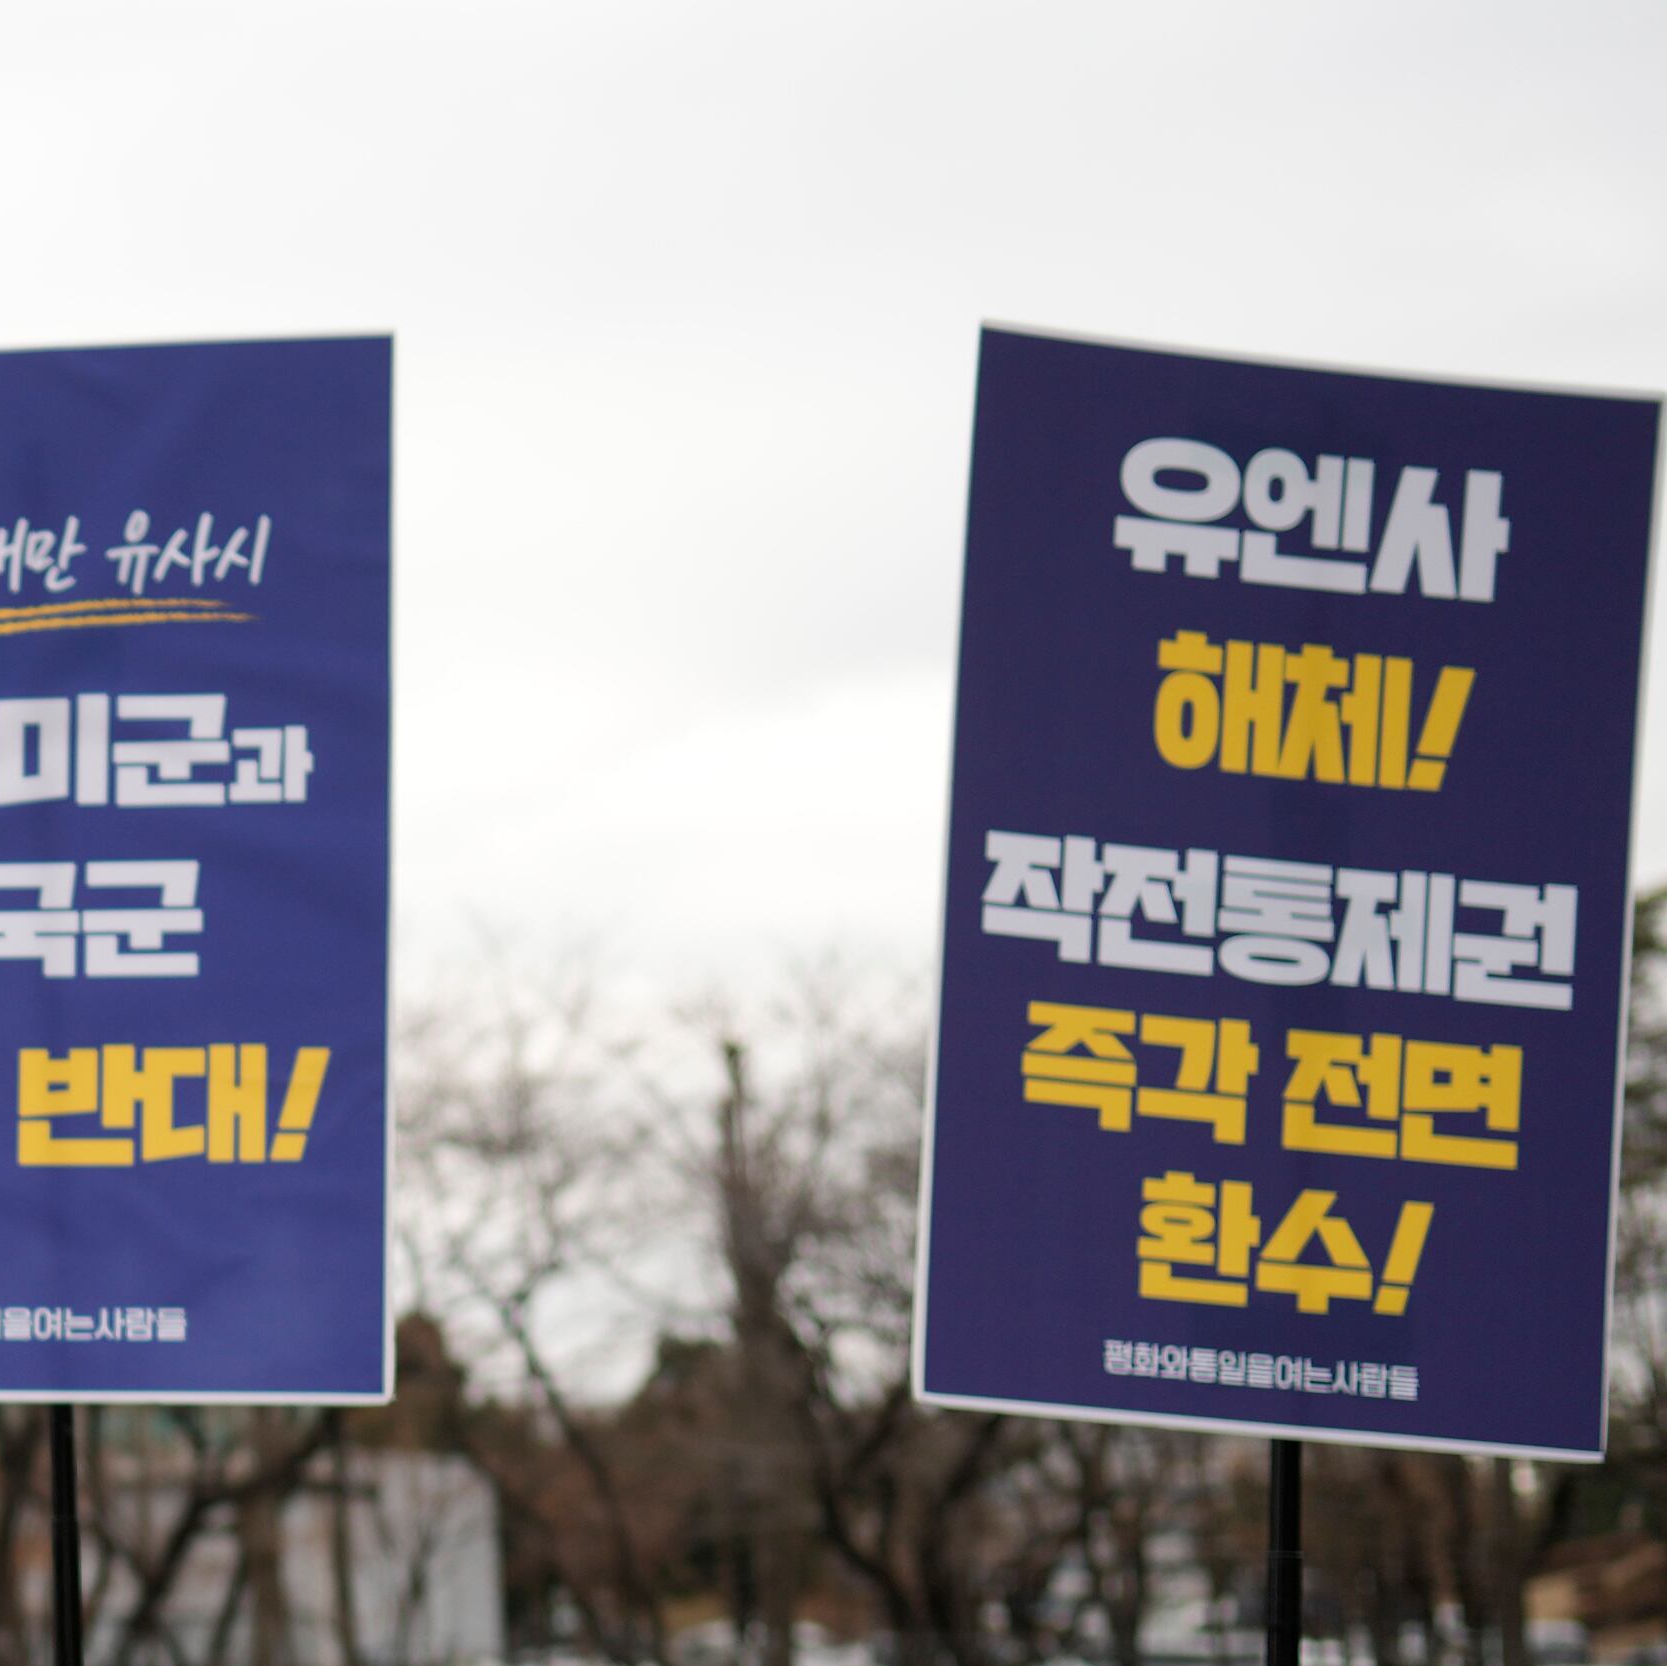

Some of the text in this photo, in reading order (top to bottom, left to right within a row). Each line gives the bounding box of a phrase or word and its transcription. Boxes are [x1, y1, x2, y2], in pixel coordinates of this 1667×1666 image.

[106, 510, 270, 594] 유사시
[1114, 438, 1509, 602] 유엔사
[1155, 630, 1474, 791] 해체!
[982, 830, 1577, 1010] 작전통제권
[18, 1044, 330, 1166] 반대!
[1022, 1001, 1522, 1169] 즉각 전면
[1137, 1171, 1433, 1315] 환수!
[1104, 1340, 1418, 1400] 평화와통일을여는사람들
